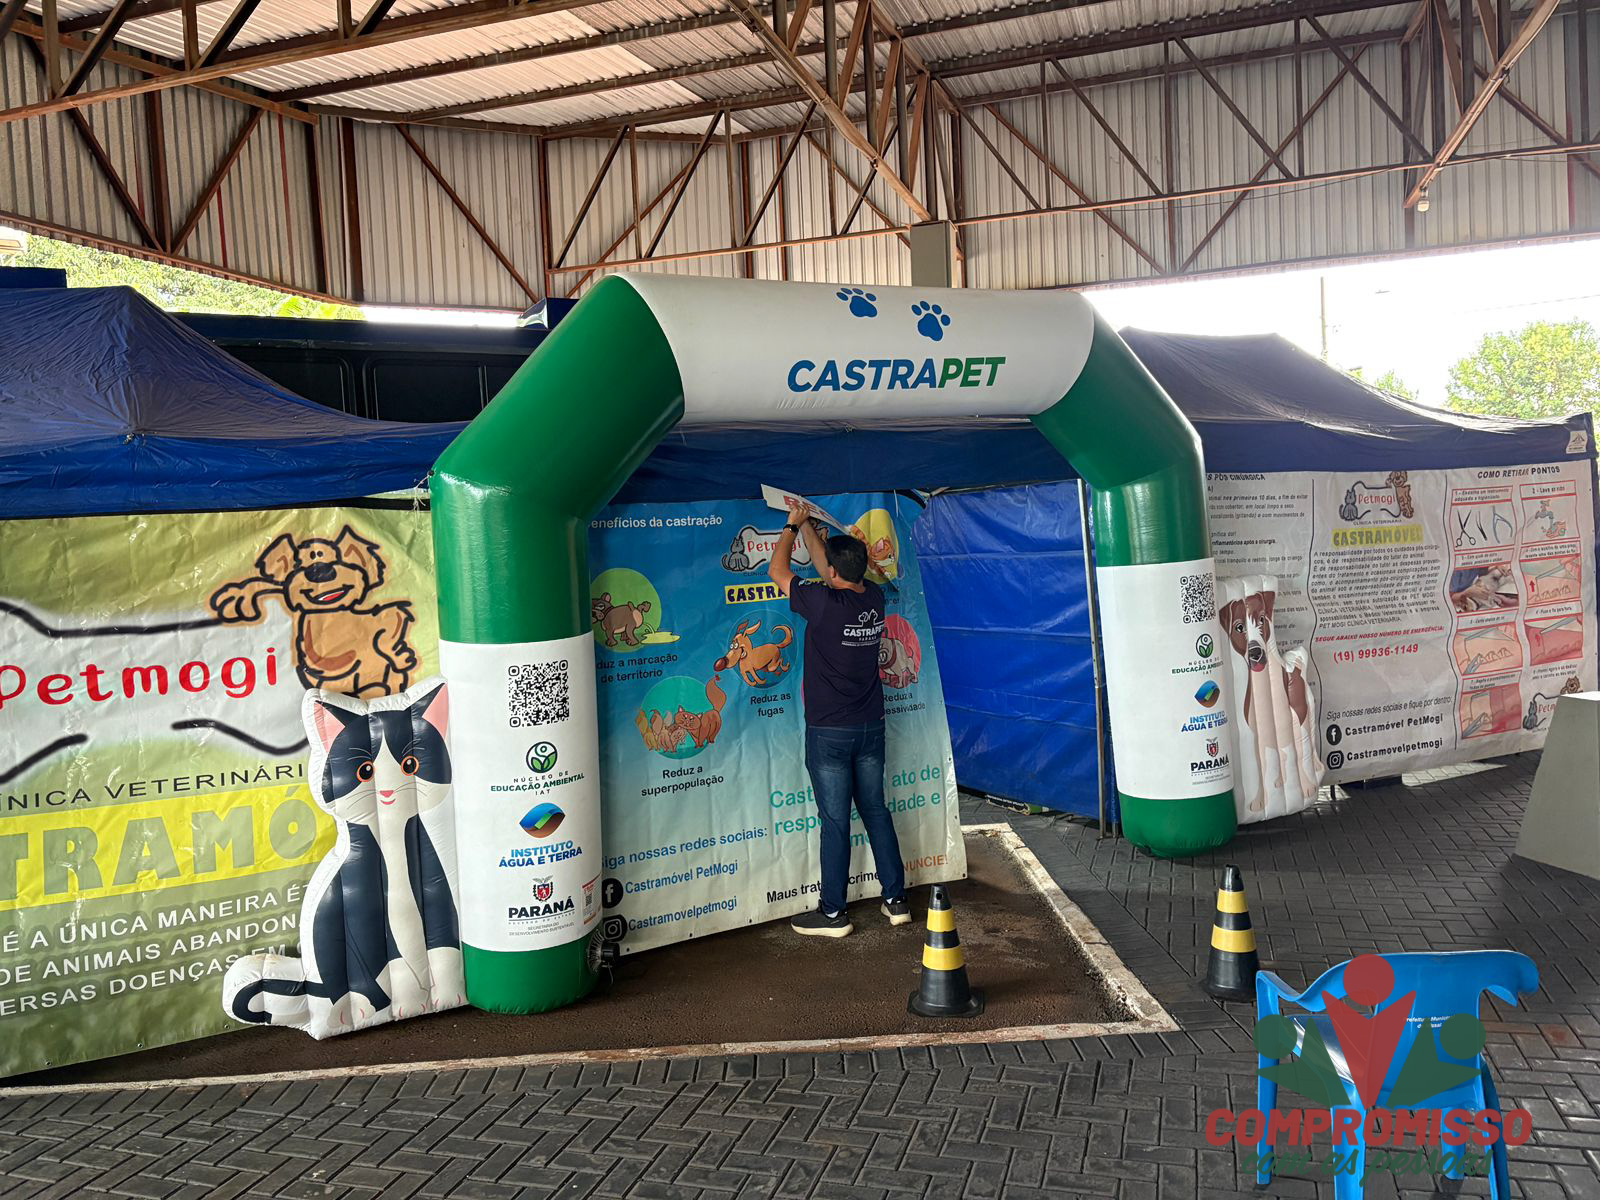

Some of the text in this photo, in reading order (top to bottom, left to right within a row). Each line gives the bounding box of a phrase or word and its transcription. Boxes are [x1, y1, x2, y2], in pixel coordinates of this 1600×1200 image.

[787, 356, 1007, 393] CASTRAPET
[1477, 465, 1561, 479] COMO RETIRAR PONTOS
[588, 514, 724, 530] enefícios da castração
[1319, 549, 1363, 557] responsabilidade
[727, 585, 789, 603] CASTRA
[1358, 632, 1378, 640] NOSSO
[596, 653, 679, 671] duz a marcação
[1333, 643, 1420, 665] (19) 99936-1149
[600, 669, 664, 684] de território
[1171, 663, 1207, 675] EDUCAÇÃO
[749, 692, 792, 706] Reduz as
[907, 691, 914, 700] a
[757, 704, 785, 719] fugas
[1189, 711, 1226, 724] INSTITUTO
[1326, 710, 1342, 722] Siga
[1341, 707, 1364, 719] nossas
[1364, 705, 1382, 715] redes
[1382, 701, 1403, 713] sociais
[1408, 699, 1423, 710] fique
[1423, 699, 1434, 709] por
[1181, 723, 1208, 733] ÁGUA
[1207, 721, 1214, 729] E
[1344, 713, 1444, 737] Castramóvel PetMogi
[1346, 737, 1444, 762] Castramovelpetmogi
[1190, 753, 1230, 772] PARANÁ
[513, 769, 570, 784] NÚCLEO DE
[662, 766, 704, 780] Reduz a
[0, 763, 304, 812] NICA VETERINÁRI
[490, 772, 586, 794] EDUCAÇÃO AMBIENTAL
[535, 788, 551, 796] IAT
[641, 774, 725, 798] superpopulação
[769, 764, 941, 809] Cast ato de
[930, 791, 942, 805] e
[510, 840, 574, 858] INSTITUTO
[629, 844, 677, 865] nossas
[679, 836, 717, 854] redes
[719, 827, 768, 846] sociais:
[498, 846, 584, 868] ÁGUA E TERRA
[625, 859, 739, 895] Castramóvel PetMogi
[766, 886, 798, 904] Maus
[800, 880, 822, 896] trat
[903, 854, 949, 873] NUNCIE!
[508, 895, 576, 920] PARANÁ
[628, 895, 738, 932] Castramovelpetmogi
[3, 933, 20, 953] É
[30, 930, 49, 949] A
[60, 915, 149, 945] ÚNICA
[157, 892, 279, 930] MANEIRA
[42, 943, 162, 980] ANIMAIS
[170, 913, 301, 957] ABANDON
